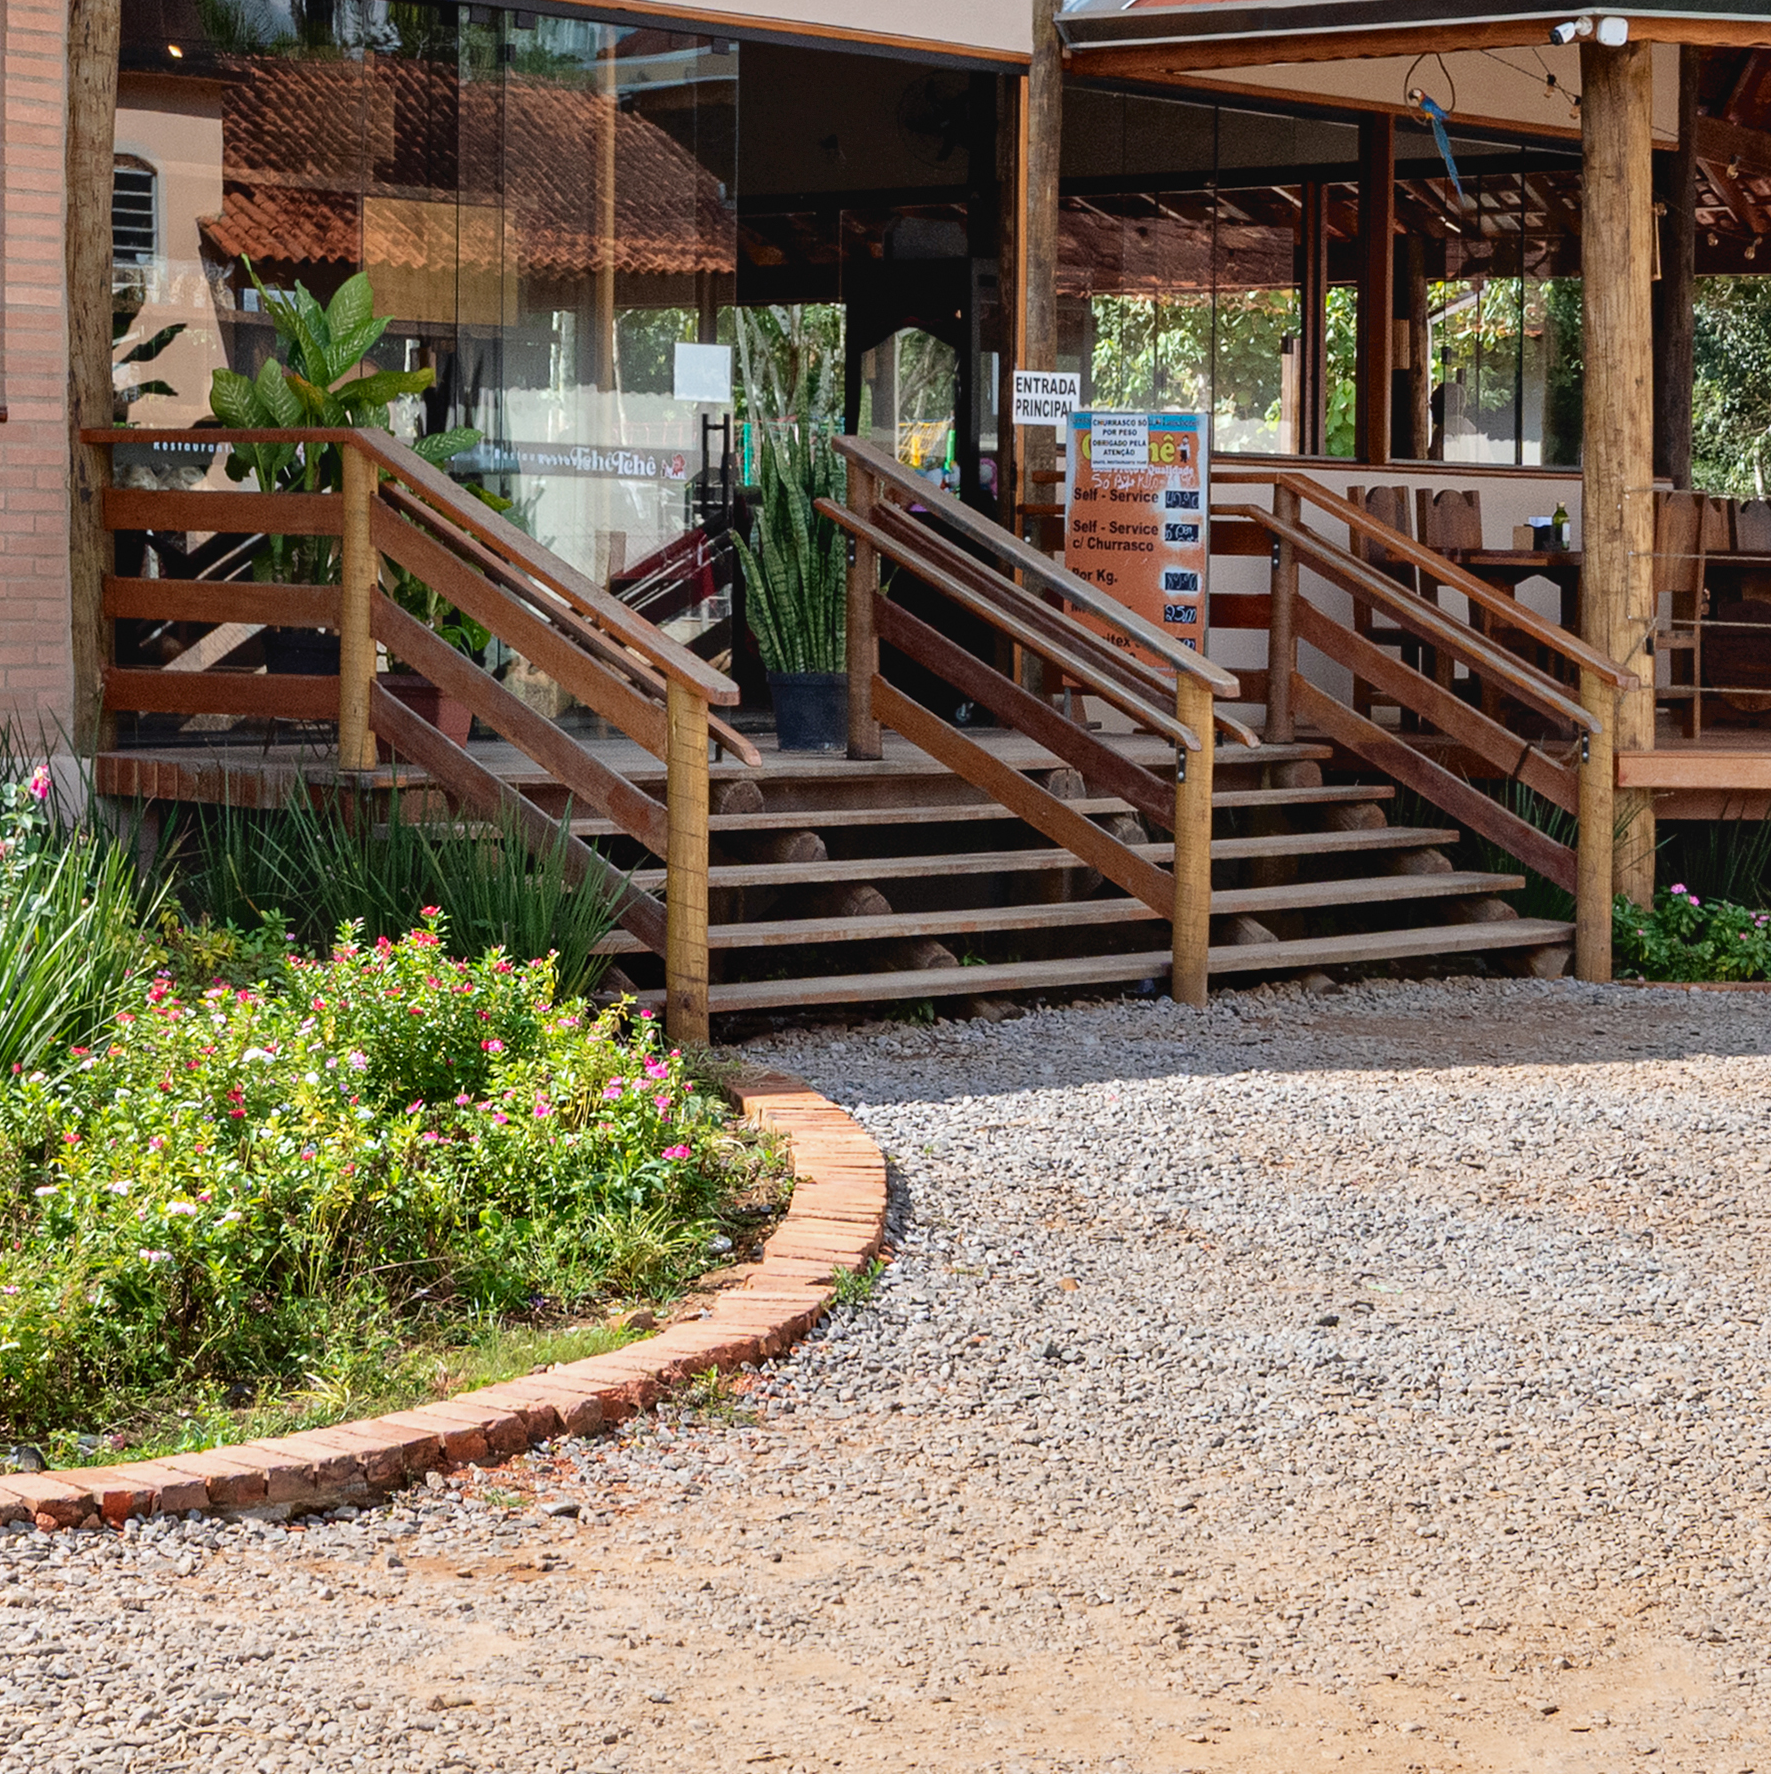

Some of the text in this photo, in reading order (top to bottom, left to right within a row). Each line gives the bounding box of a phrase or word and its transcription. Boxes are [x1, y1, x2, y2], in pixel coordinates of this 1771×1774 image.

[1016, 376, 1077, 395] ENTRADA
[1016, 399, 1073, 418] PRINCIPAL
[1138, 418, 1147, 426] SÓ
[153, 442, 235, 453] Restaurant
[1103, 448, 1135, 457] ATENÇÃO
[612, 451, 657, 476] Tchê
[1074, 487, 1097, 501] Self
[1110, 489, 1159, 503] Service
[1073, 520, 1097, 533] Self
[1109, 521, 1159, 535] Service
[1073, 537, 1154, 552] c/ Churrasco
[1096, 569, 1118, 585] Kg.
